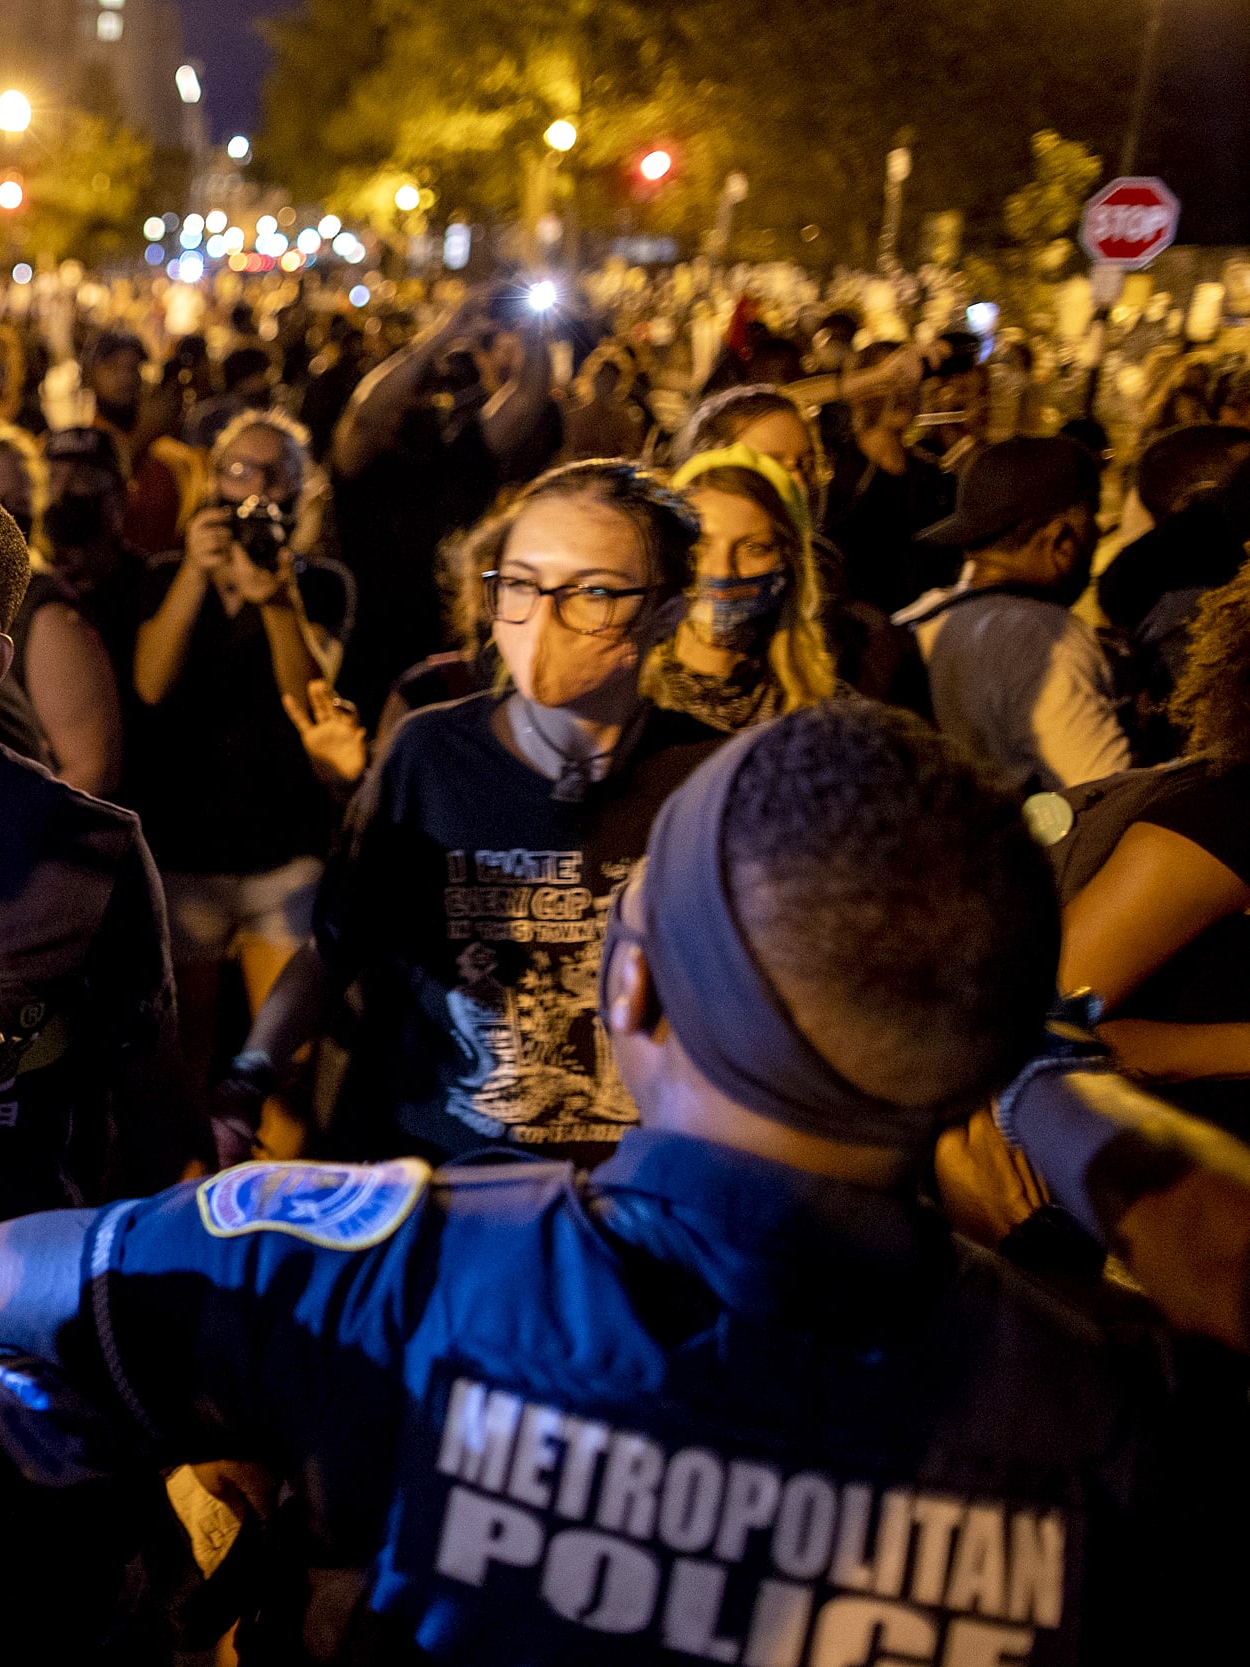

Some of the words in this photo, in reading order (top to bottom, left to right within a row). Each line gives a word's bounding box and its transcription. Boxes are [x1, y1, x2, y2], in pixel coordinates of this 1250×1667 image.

[1091, 203, 1167, 243] STOP
[436, 1376, 1063, 1629] METROPOLITAN
[436, 1484, 1036, 1667] POLICE
